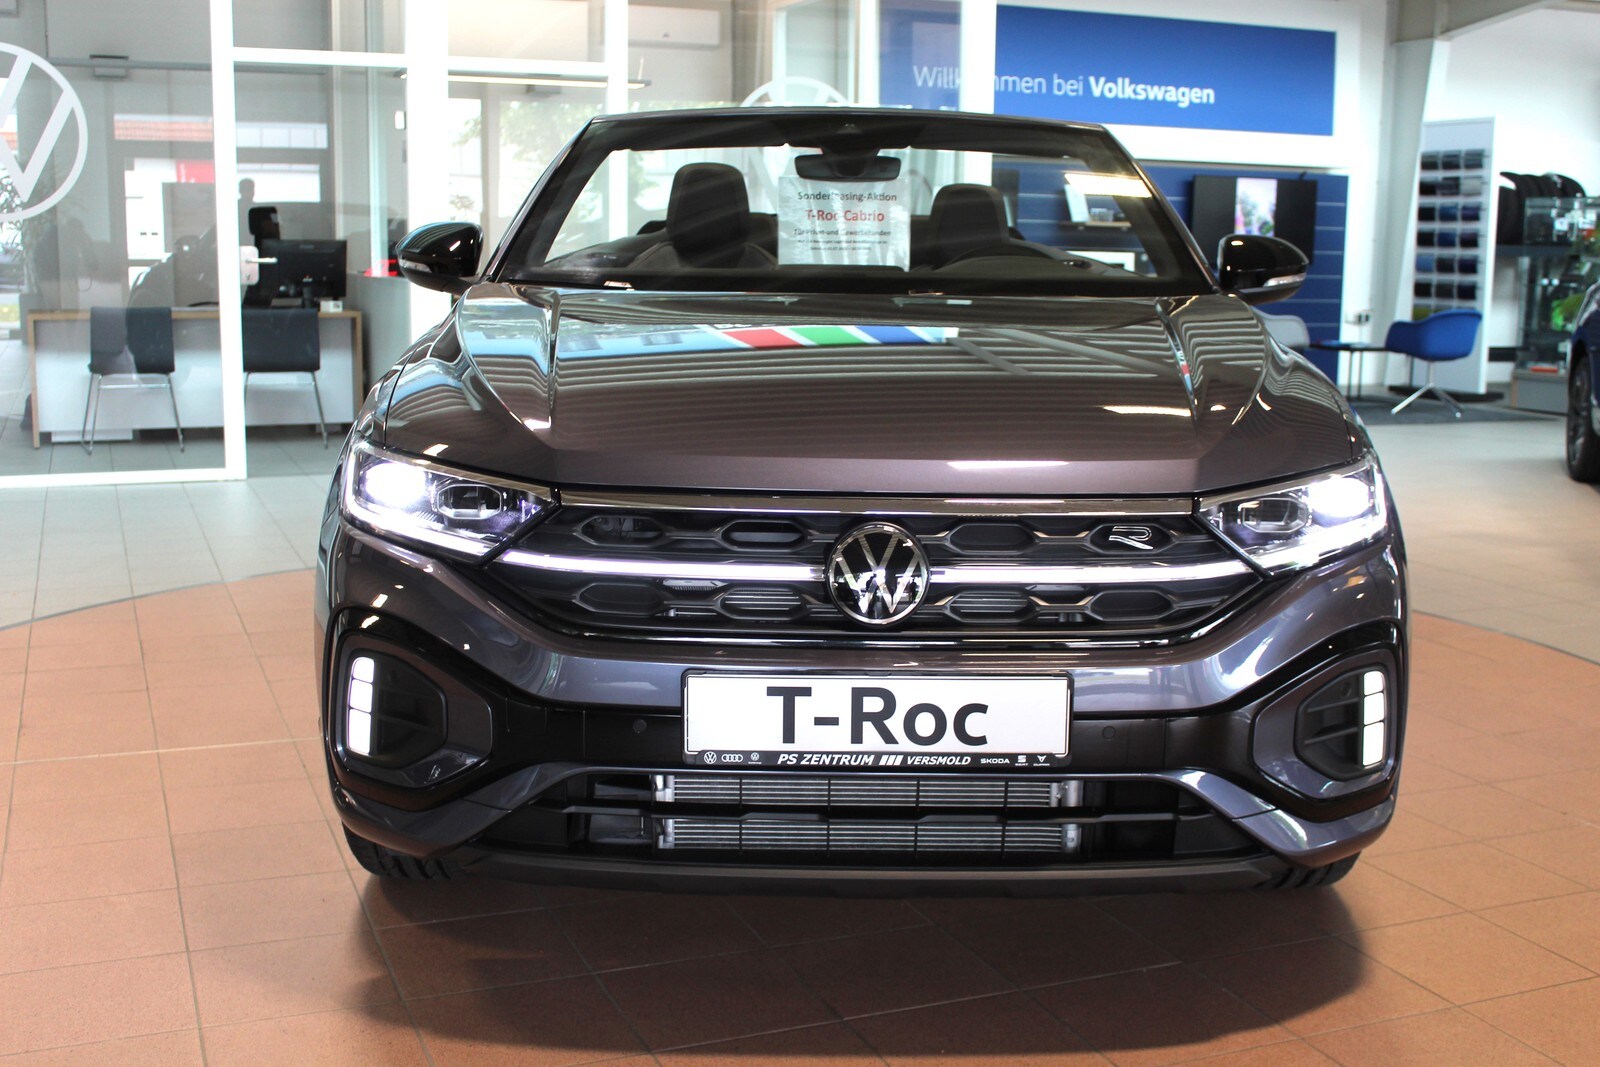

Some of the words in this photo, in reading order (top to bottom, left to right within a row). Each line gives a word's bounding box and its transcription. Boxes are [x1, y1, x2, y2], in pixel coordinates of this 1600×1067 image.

[913, 65, 1046, 94] Willmen
[1053, 73, 1083, 96] bei
[1088, 75, 1215, 108] Volkswagen
[797, 191, 897, 202] Sonderasing-Aktion
[843, 209, 885, 222] Cabrio
[766, 686, 989, 747] T-Roc
[777, 753, 799, 765] PS
[800, 753, 875, 766] ZENTRUM
[906, 755, 972, 766] VERSMOLD
